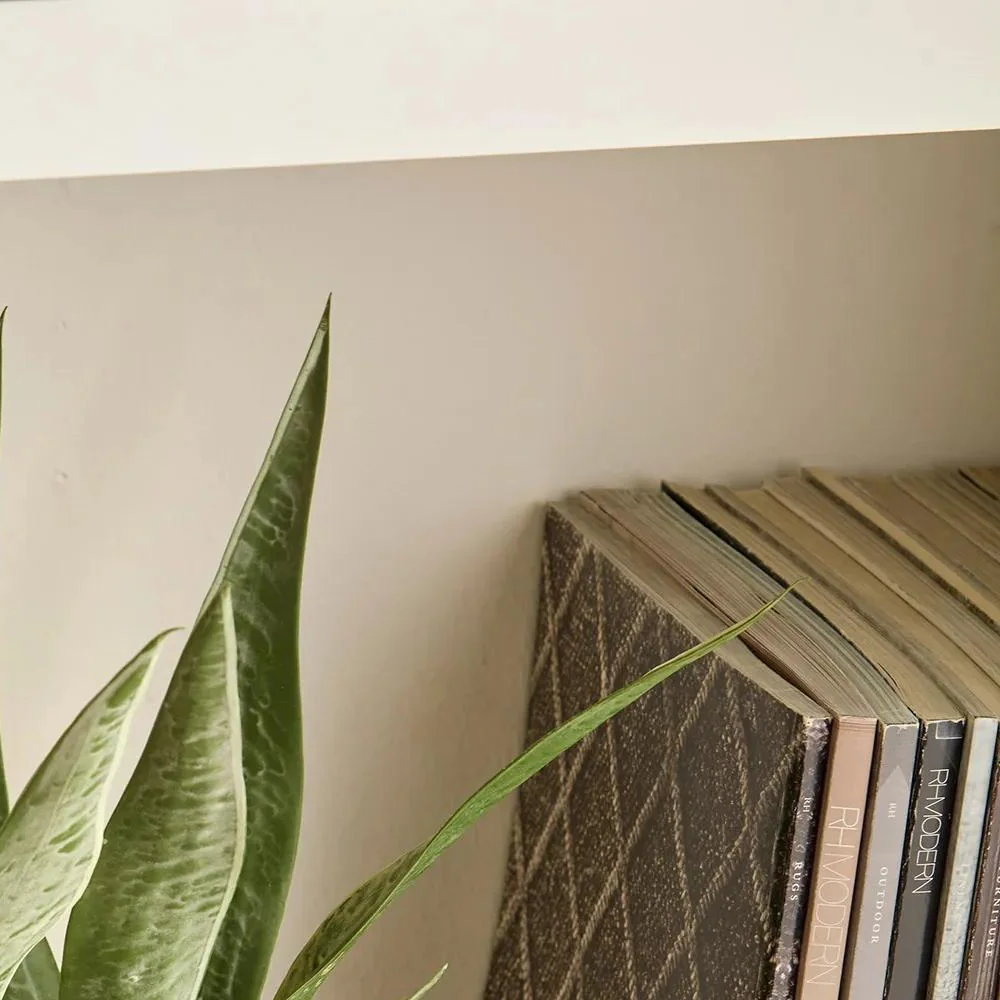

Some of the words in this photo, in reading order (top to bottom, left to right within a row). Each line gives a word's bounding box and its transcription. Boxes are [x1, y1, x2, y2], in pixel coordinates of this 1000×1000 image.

[803, 797, 814, 813] RH
[887, 802, 897, 819] RH
[911, 768, 949, 894] RHMODERN
[790, 861, 804, 901] RUGS
[805, 806, 861, 986] RHMODERN
[870, 866, 889, 944] OUTDOOR
